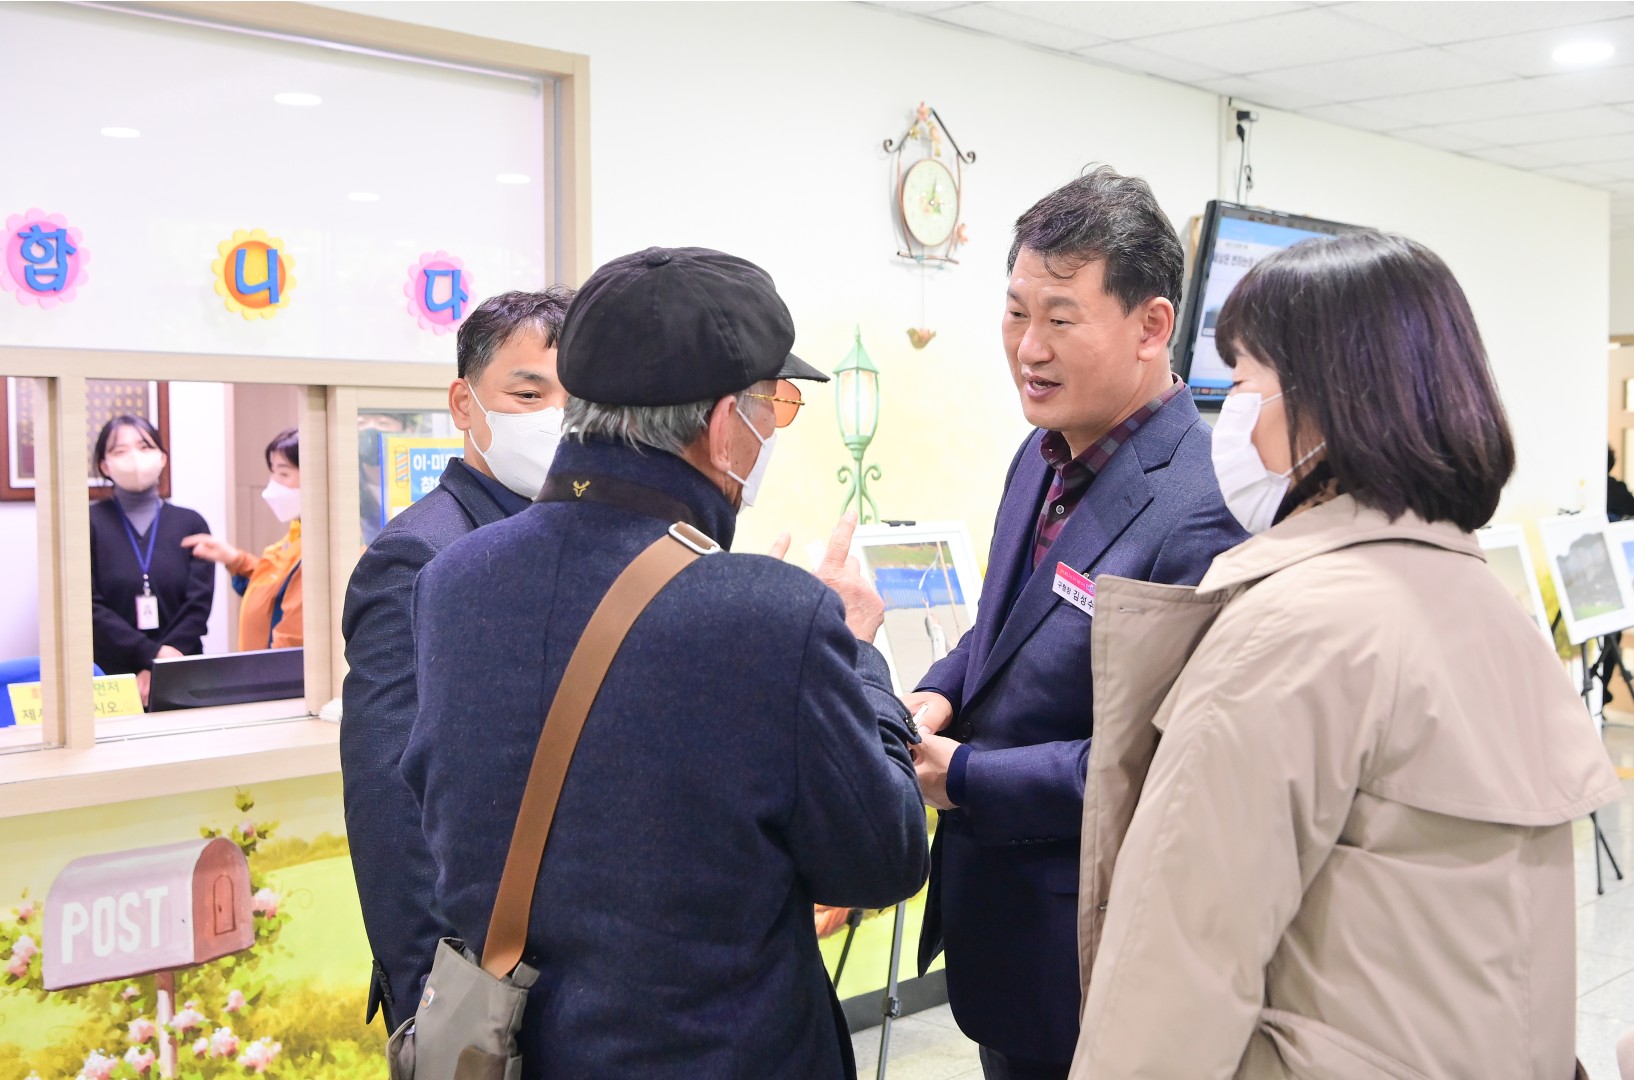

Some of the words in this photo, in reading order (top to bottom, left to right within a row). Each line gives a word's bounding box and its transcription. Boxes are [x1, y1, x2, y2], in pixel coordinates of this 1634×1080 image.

[1057, 580, 1072, 595] 구청장
[1073, 590, 1094, 610] 김성수
[93, 681, 121, 697] 먼저
[61, 886, 169, 964] POST
